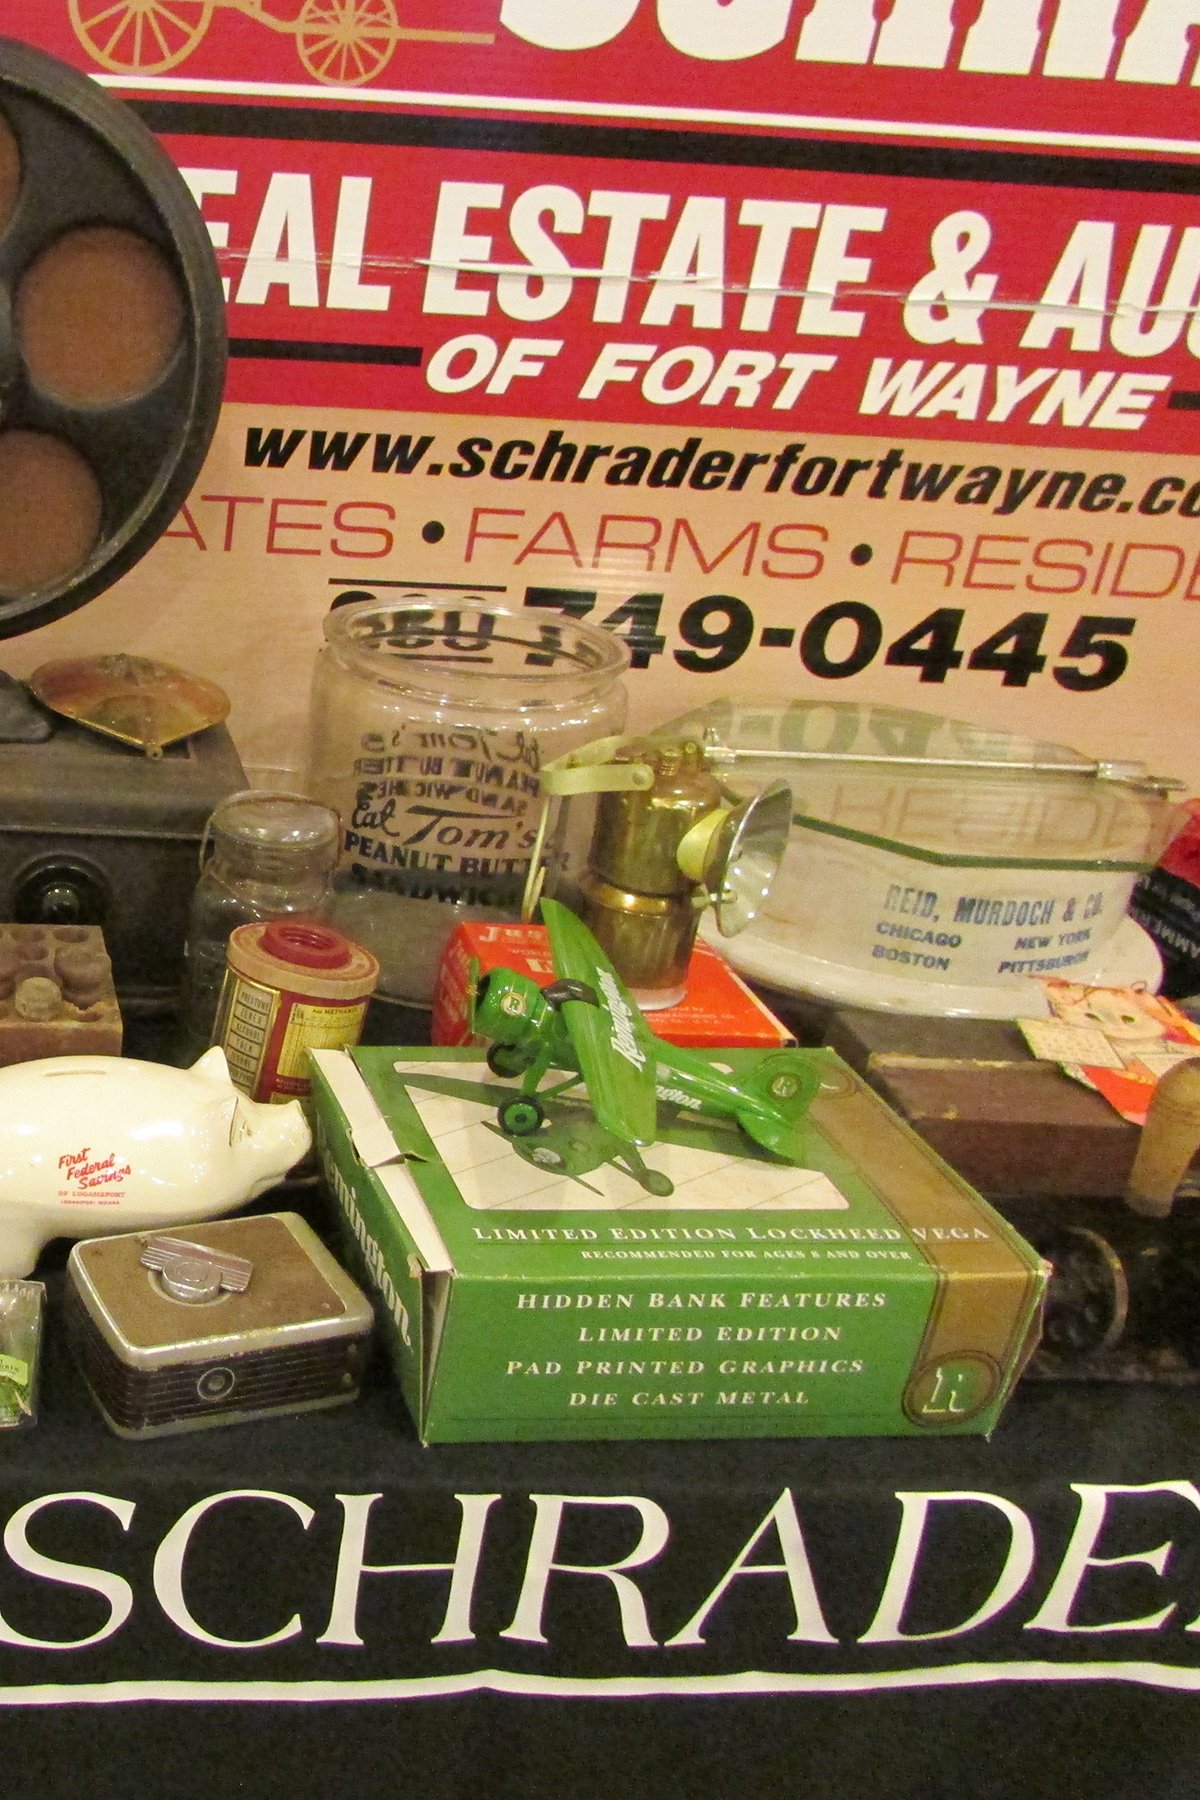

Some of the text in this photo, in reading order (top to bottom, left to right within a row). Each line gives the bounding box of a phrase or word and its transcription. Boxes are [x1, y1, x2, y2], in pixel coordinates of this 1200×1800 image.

[422, 180, 886, 338] ESTATE
[902, 209, 992, 346] &
[1020, 219, 1200, 359] AU
[426, 334, 1175, 431] OF FORT WAYNE
[466, 507, 830, 582] FARMS
[891, 532, 1200, 601] RESID
[403, 804, 540, 850] Tom's
[344, 829, 453, 873] PEANUT
[953, 895, 1056, 927] MURDOCH
[875, 920, 962, 948] CHICAGO
[1014, 935, 1052, 950] NEW
[872, 944, 951, 970] BOSTON
[58, 1147, 91, 1169] First
[66, 1152, 116, 1181] Federal
[77, 1164, 132, 1190] Savings
[471, 1225, 991, 1241] LIMITED EDITION LOCKHEED VEGA
[580, 1249, 717, 1260] RECOMMENDED
[721, 1250, 758, 1260] FOR
[762, 1250, 807, 1260] AGES
[825, 1250, 861, 1260] AND
[865, 1250, 914, 1261] OVER
[516, 1291, 889, 1310] HIDDEN BANK FEATURES
[577, 1325, 844, 1343] LIMITED EDITION
[506, 1358, 866, 1376] PAD PRINTED GRAPHICS
[568, 1391, 811, 1406] DIE CAST METAL
